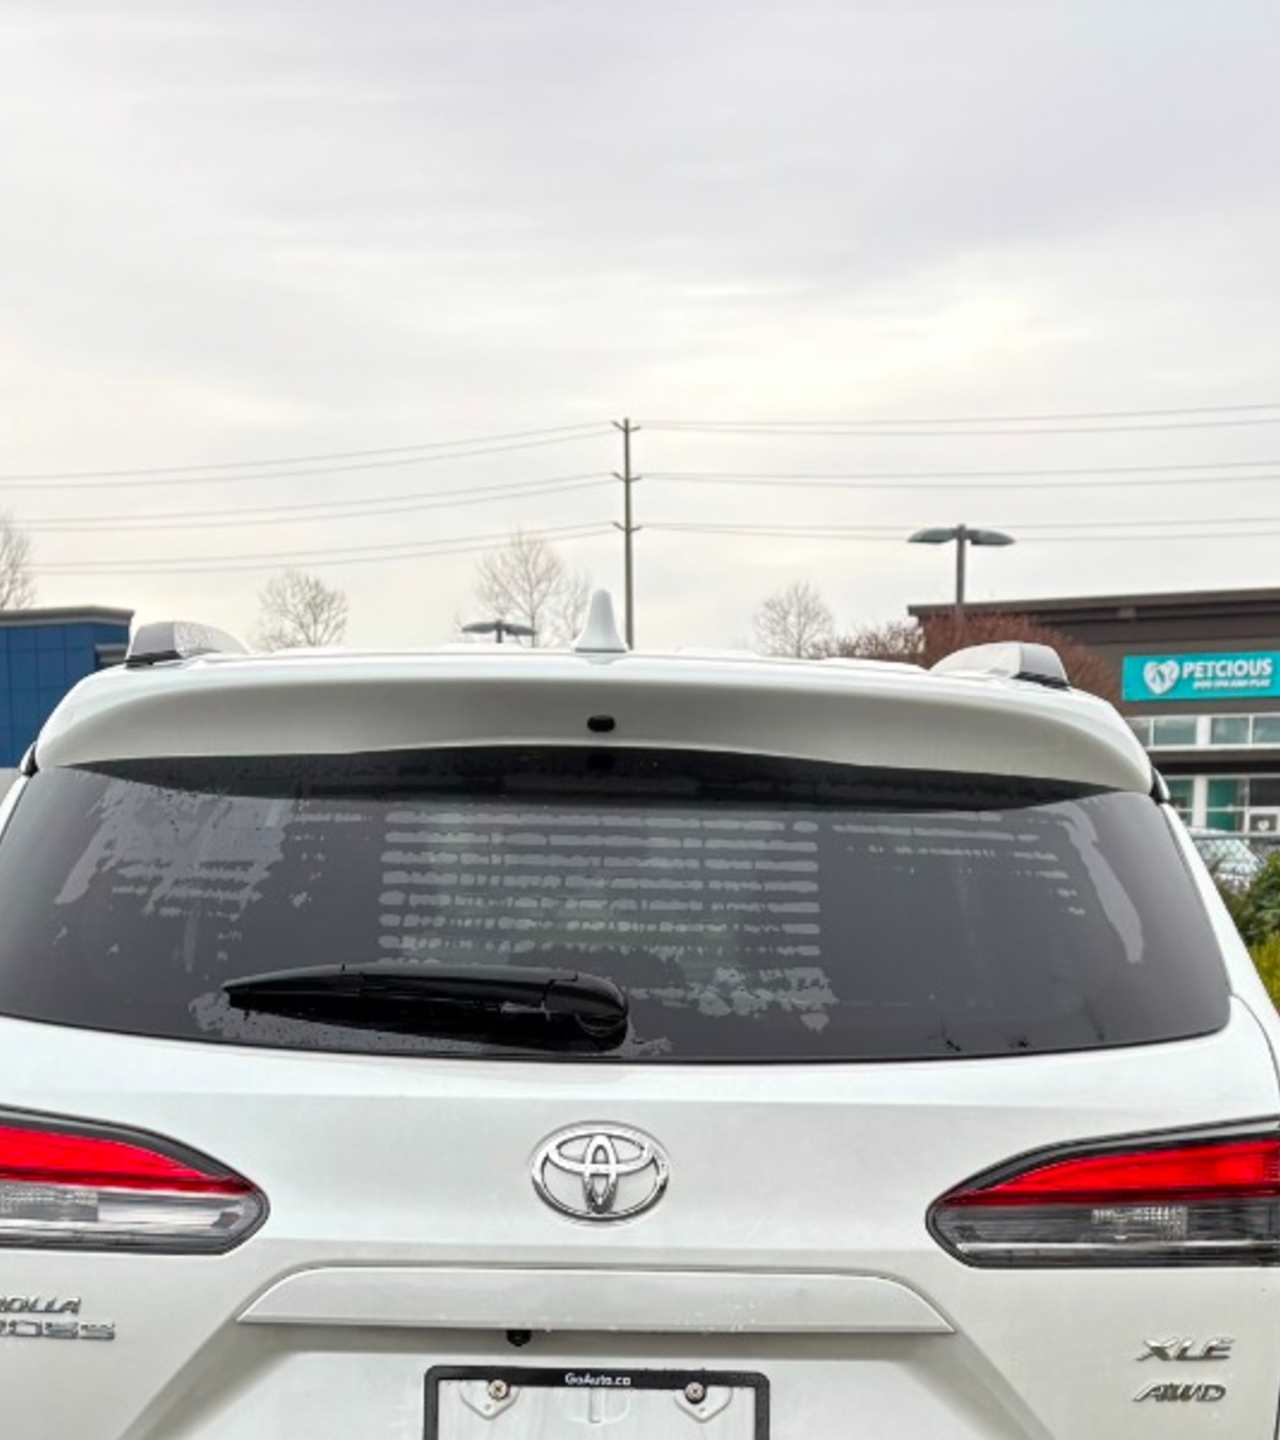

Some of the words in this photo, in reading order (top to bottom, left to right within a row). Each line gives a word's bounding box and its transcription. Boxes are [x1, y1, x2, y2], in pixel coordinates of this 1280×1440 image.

[1182, 658, 1272, 678] PETCIOUS
[1135, 1337, 1236, 1362] XLE
[1132, 1382, 1227, 1403] AWD
